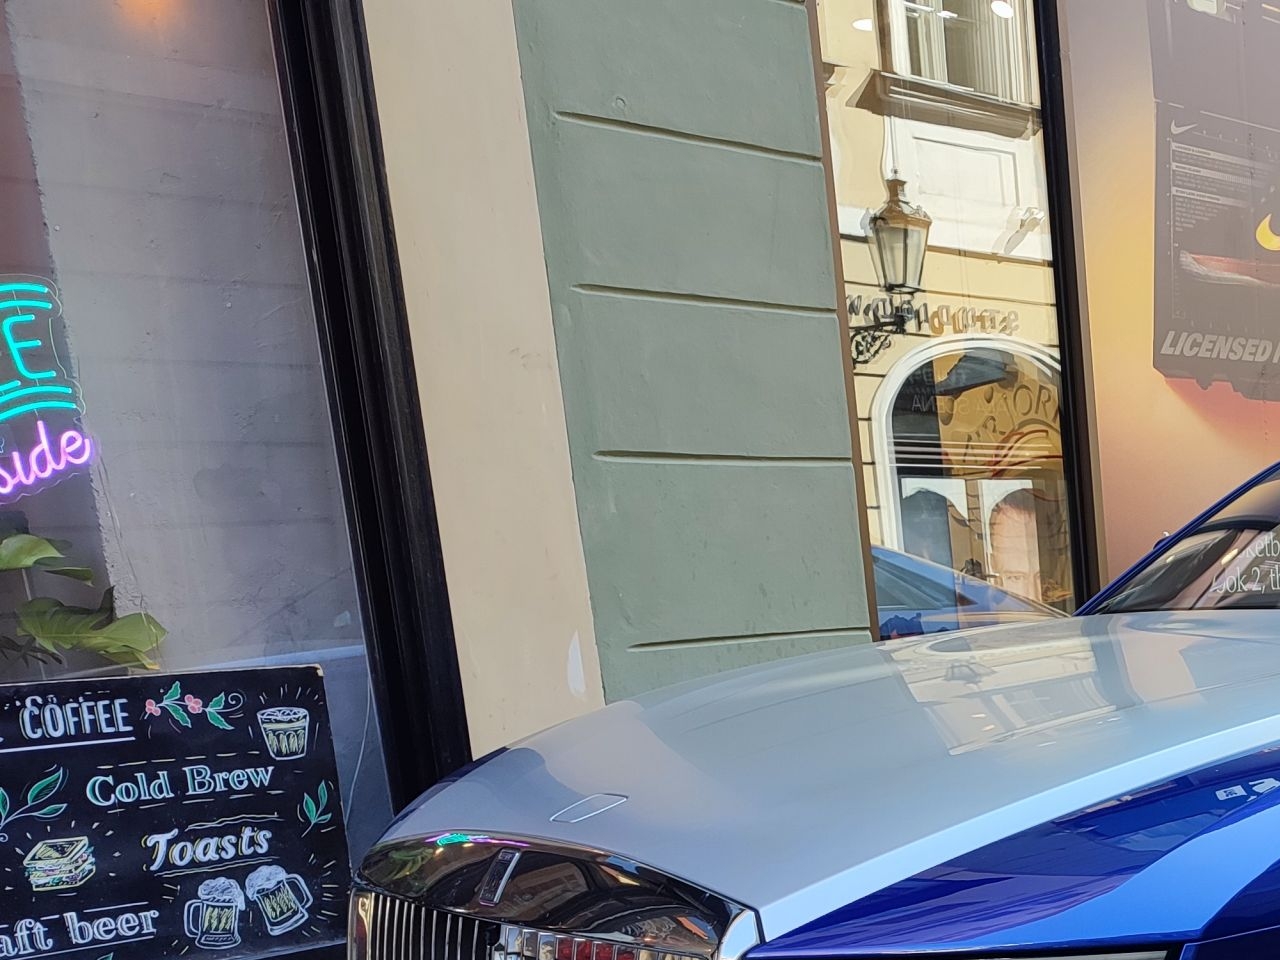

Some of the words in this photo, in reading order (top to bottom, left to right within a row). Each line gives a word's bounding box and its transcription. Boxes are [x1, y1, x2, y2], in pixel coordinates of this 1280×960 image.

[1160, 331, 1274, 363] LICENSED
[1251, 567, 1265, 594] 2,
[20, 698, 135, 739] COFFEE
[86, 770, 174, 806] Cold
[182, 764, 275, 795] Brew
[143, 826, 273, 870] Toasts
[63, 909, 159, 945] beer
